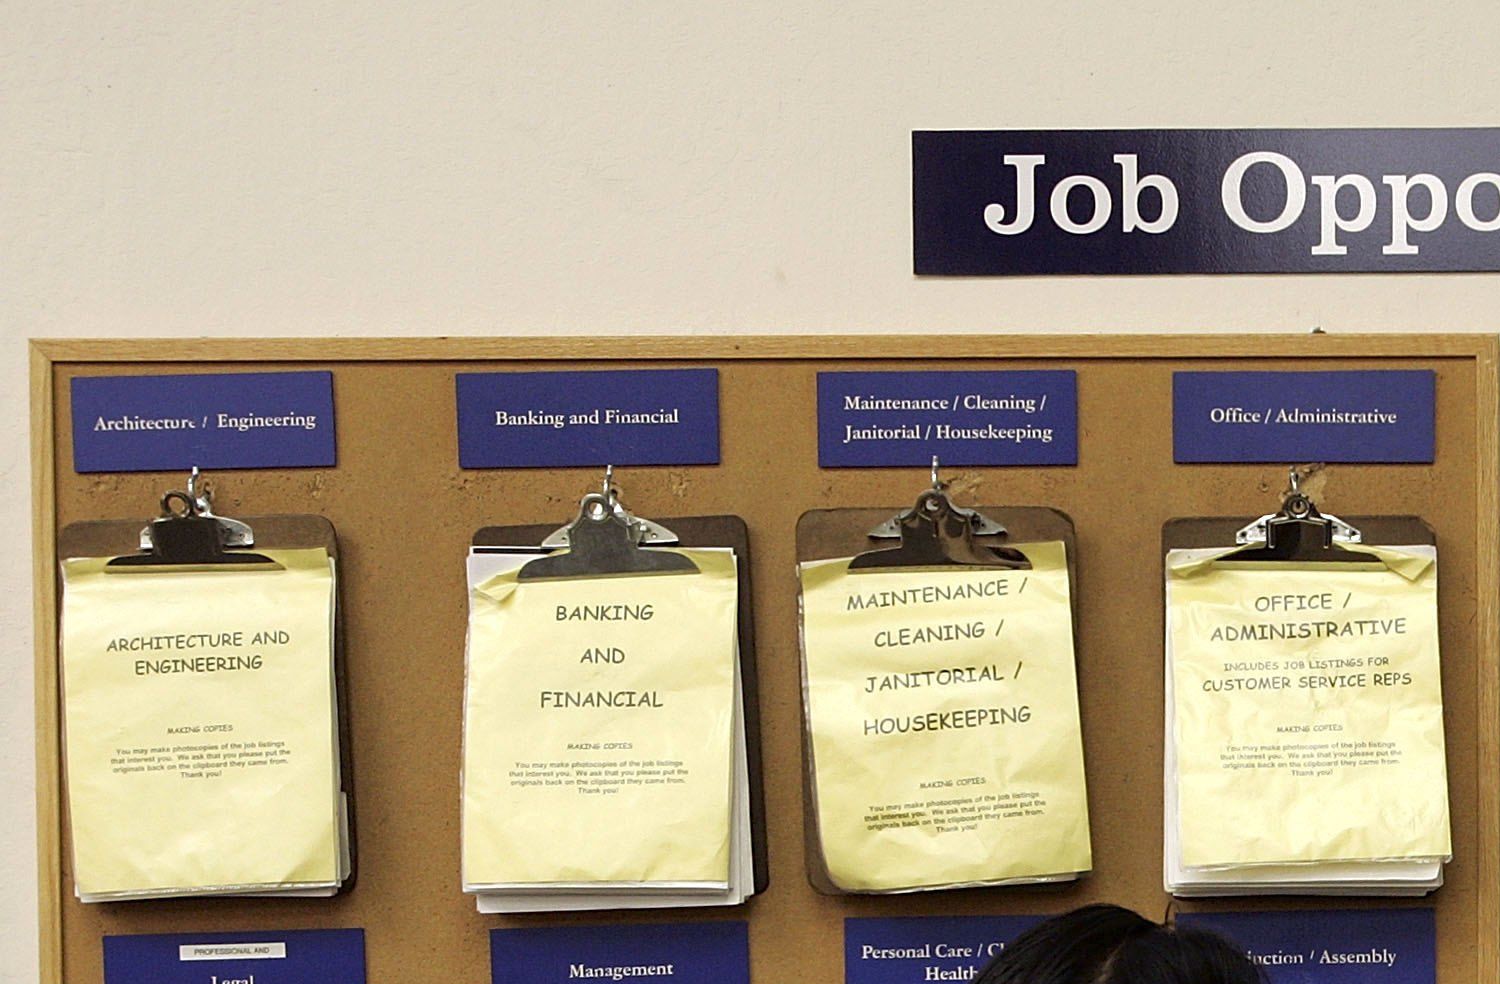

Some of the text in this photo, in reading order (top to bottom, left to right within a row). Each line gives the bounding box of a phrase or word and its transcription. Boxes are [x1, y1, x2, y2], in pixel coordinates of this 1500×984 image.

[984, 154, 1178, 234] Job
[844, 395, 948, 410] Maintenance
[963, 394, 1035, 413] Cleaning
[94, 415, 195, 431] Architecture
[217, 411, 316, 431] Engineering
[495, 408, 678, 428] Banking and Financial
[1210, 407, 1260, 422] Office
[1275, 407, 1396, 423] Administrative
[843, 424, 920, 443] Janitorial
[936, 423, 1052, 443] Housekeeping
[847, 578, 1008, 610] MAINTENANCE
[1254, 592, 1332, 612] OFFICE
[555, 604, 654, 621] BANKING
[874, 621, 985, 647] CLEANING
[1210, 617, 1405, 641] ADMINISTRATIVE
[106, 630, 289, 652] ARCHITECTURE AND
[135, 654, 262, 675] ENGINEERING
[580, 647, 625, 664] AND
[1223, 656, 1389, 671] INCLUDES JOB LISTINGS FOR
[865, 664, 1004, 693] JANITORIAL
[1202, 672, 1412, 692] CUSTOMER SERVICE REPS
[540, 690, 663, 708] FINANCIAL
[167, 724, 233, 734] MAKING COPIES
[864, 705, 1031, 735] HOUSEKEEPING
[919, 776, 986, 789] MAKING COPIES
[193, 946, 270, 955] PROFESSIONAL AND
[861, 943, 930, 959] Personal
[935, 943, 972, 958] Care
[1319, 948, 1396, 967] Assembly
[569, 963, 673, 980] Management
